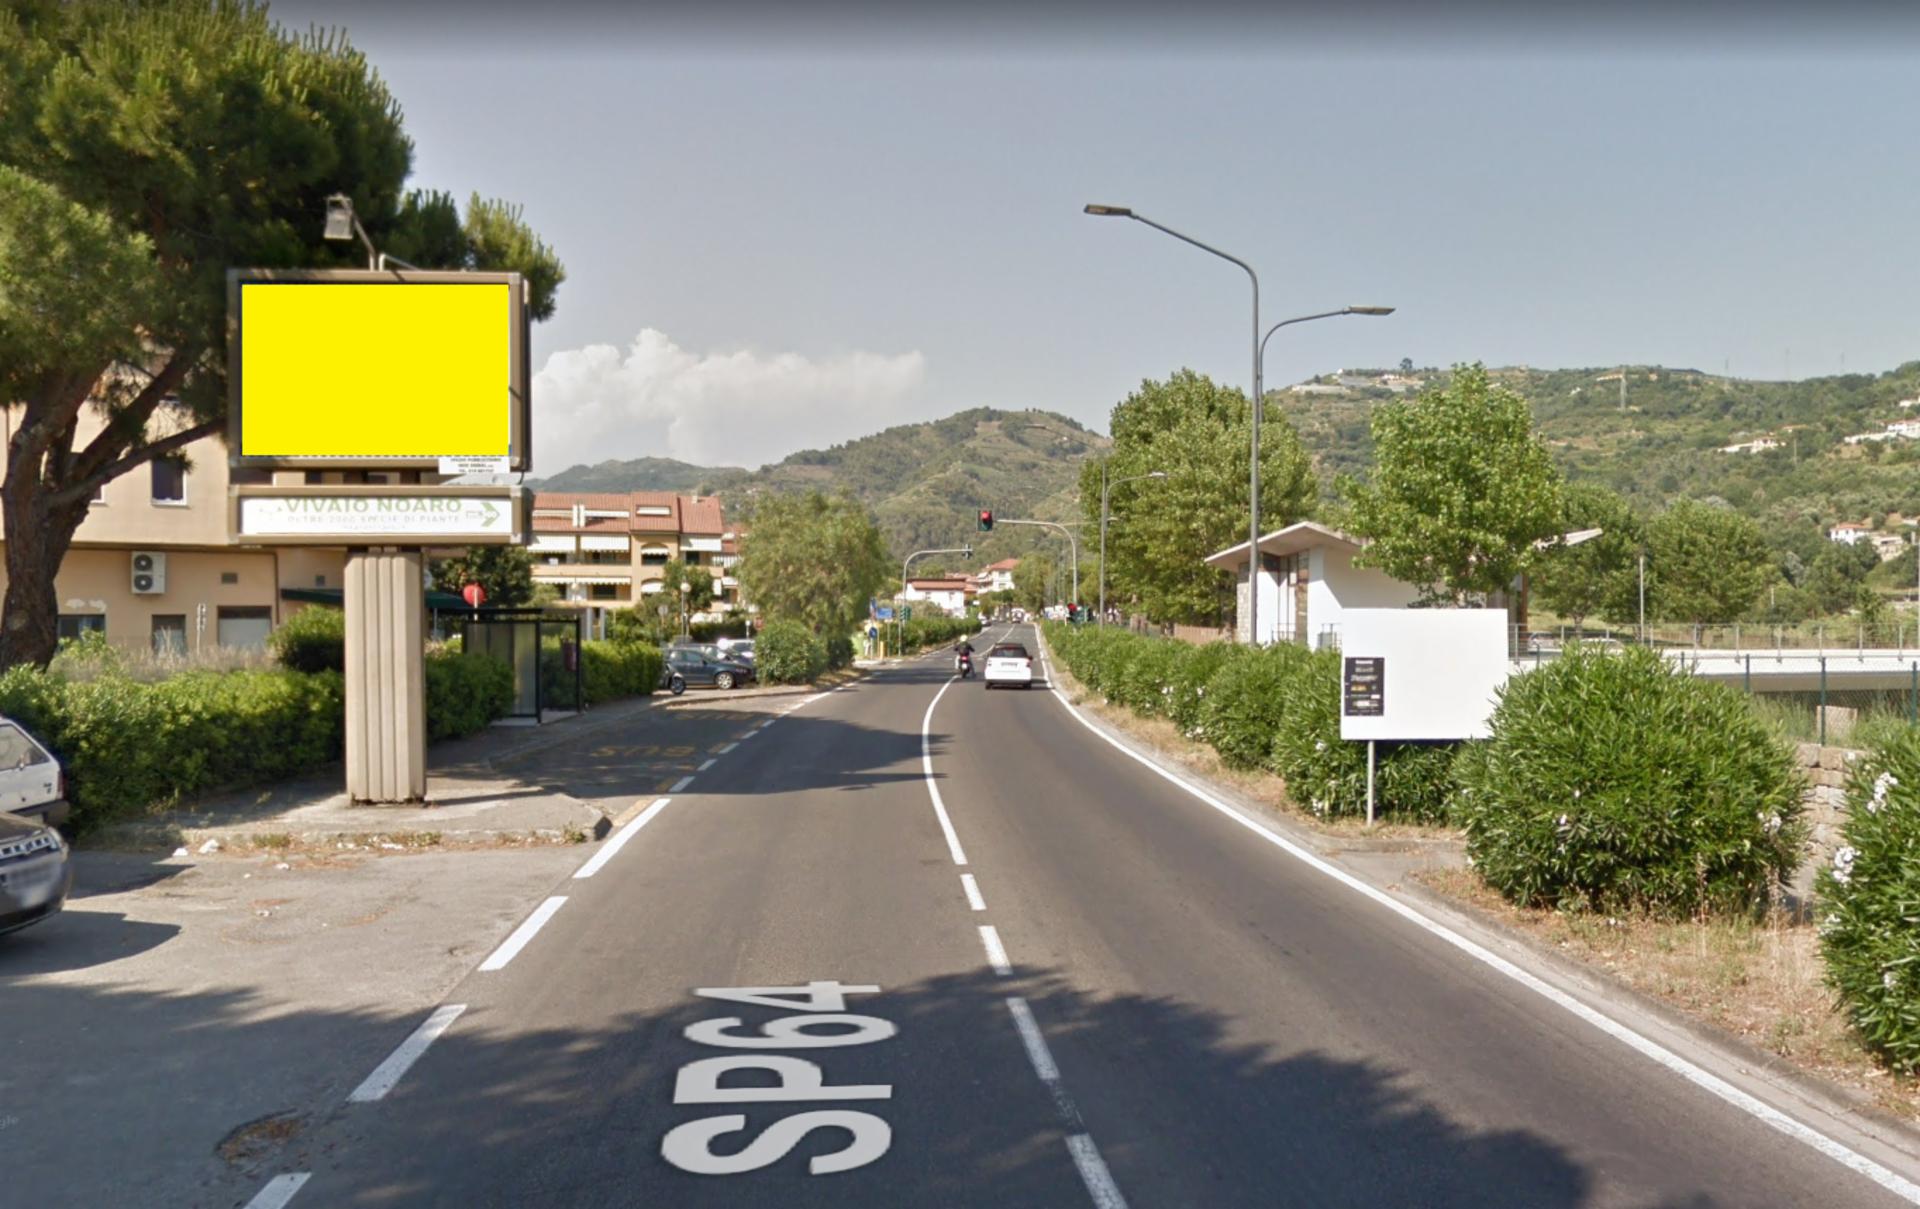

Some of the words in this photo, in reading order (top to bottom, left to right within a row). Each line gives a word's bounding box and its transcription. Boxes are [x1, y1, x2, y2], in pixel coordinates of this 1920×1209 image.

[286, 497, 369, 513] VIVAIO
[377, 497, 462, 513] NOARO
[661, 980, 899, 1175] SP64
